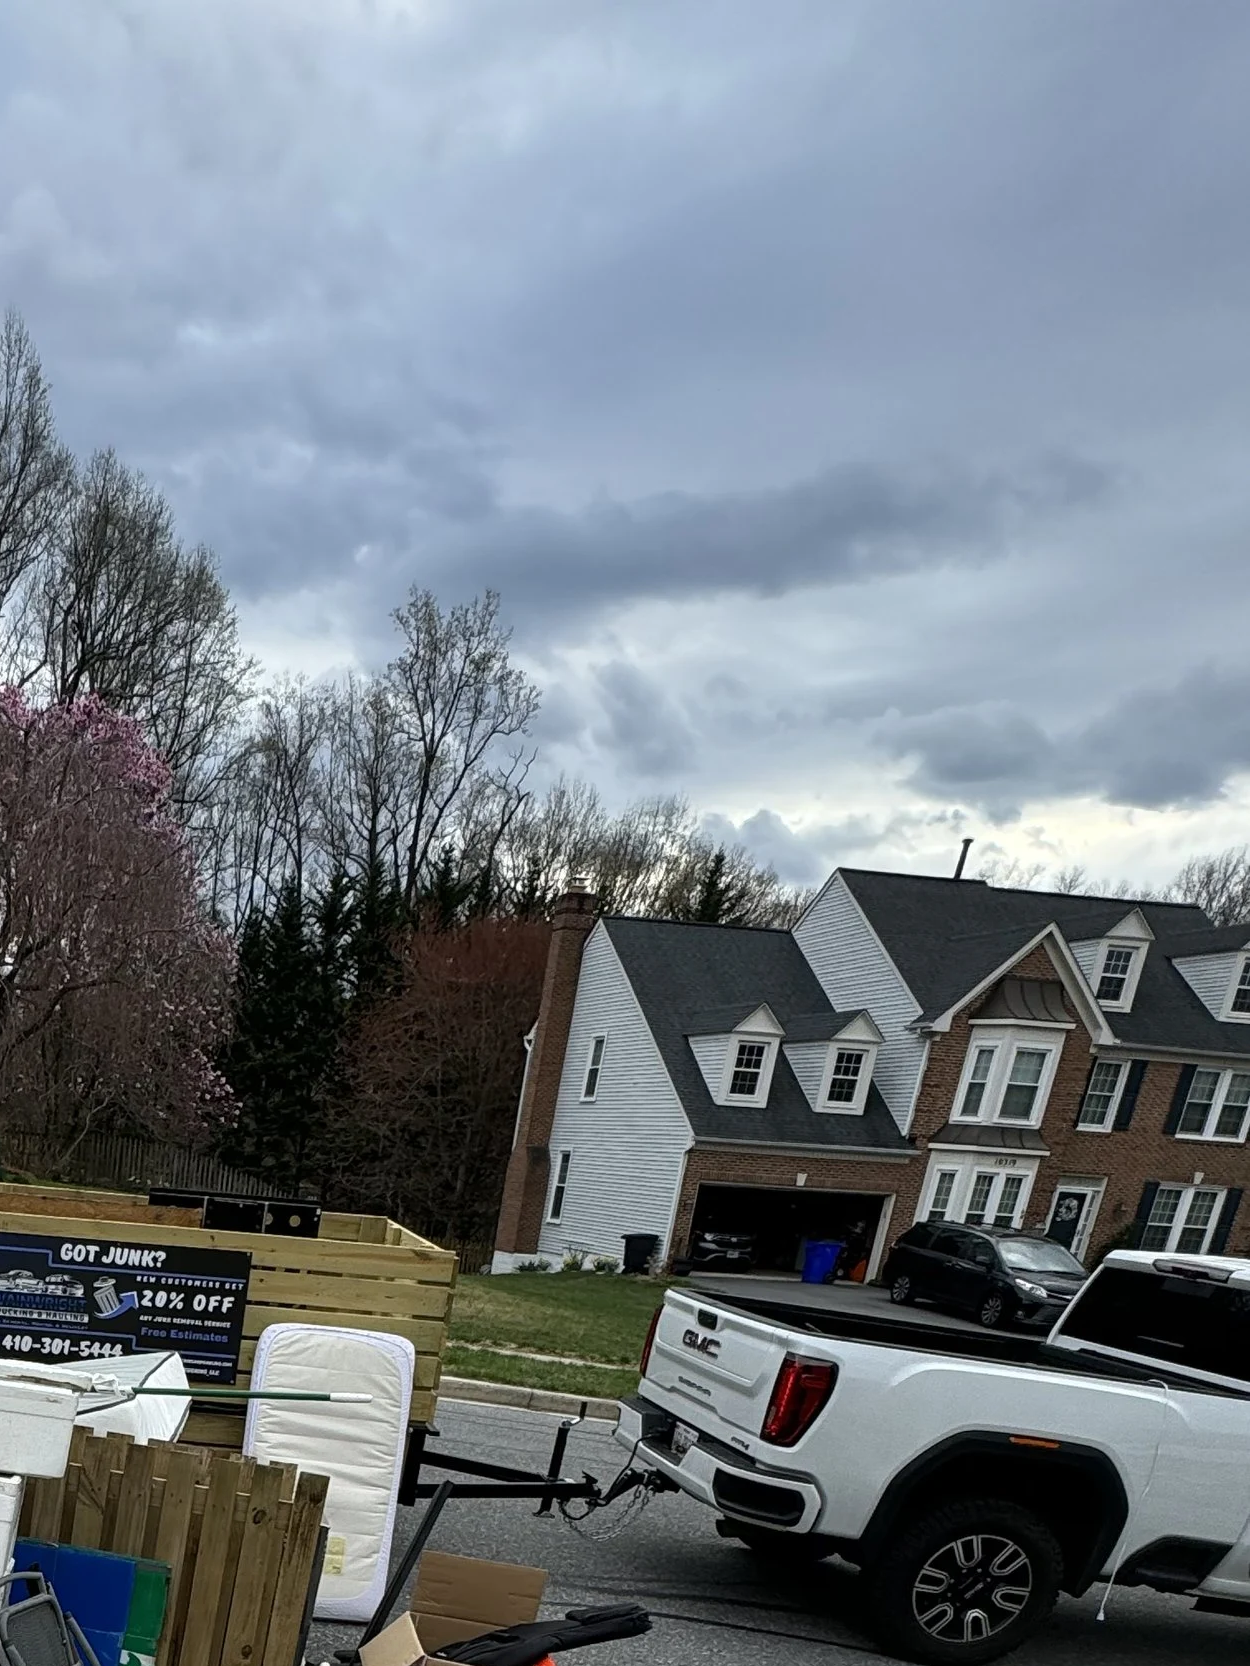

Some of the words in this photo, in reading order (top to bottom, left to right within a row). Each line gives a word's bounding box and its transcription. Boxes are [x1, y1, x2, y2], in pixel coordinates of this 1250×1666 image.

[60, 1243, 100, 1262] GOT
[101, 1246, 167, 1268] JUNK?
[136, 1275, 156, 1283] NEW
[160, 1277, 220, 1289] CUSTOMERS
[224, 1283, 244, 1291] GET
[140, 1289, 185, 1310] 20%
[192, 1294, 235, 1314] OFF
[45, 1312, 85, 1322] HAULING
[172, 1318, 203, 1326] REMOVAL
[203, 1320, 231, 1328] SERVICE
[140, 1327, 167, 1337] Free
[170, 1329, 229, 1343] Estimates
[682, 1329, 722, 1359] GMC
[2, 1334, 124, 1357] 410-301-5444
